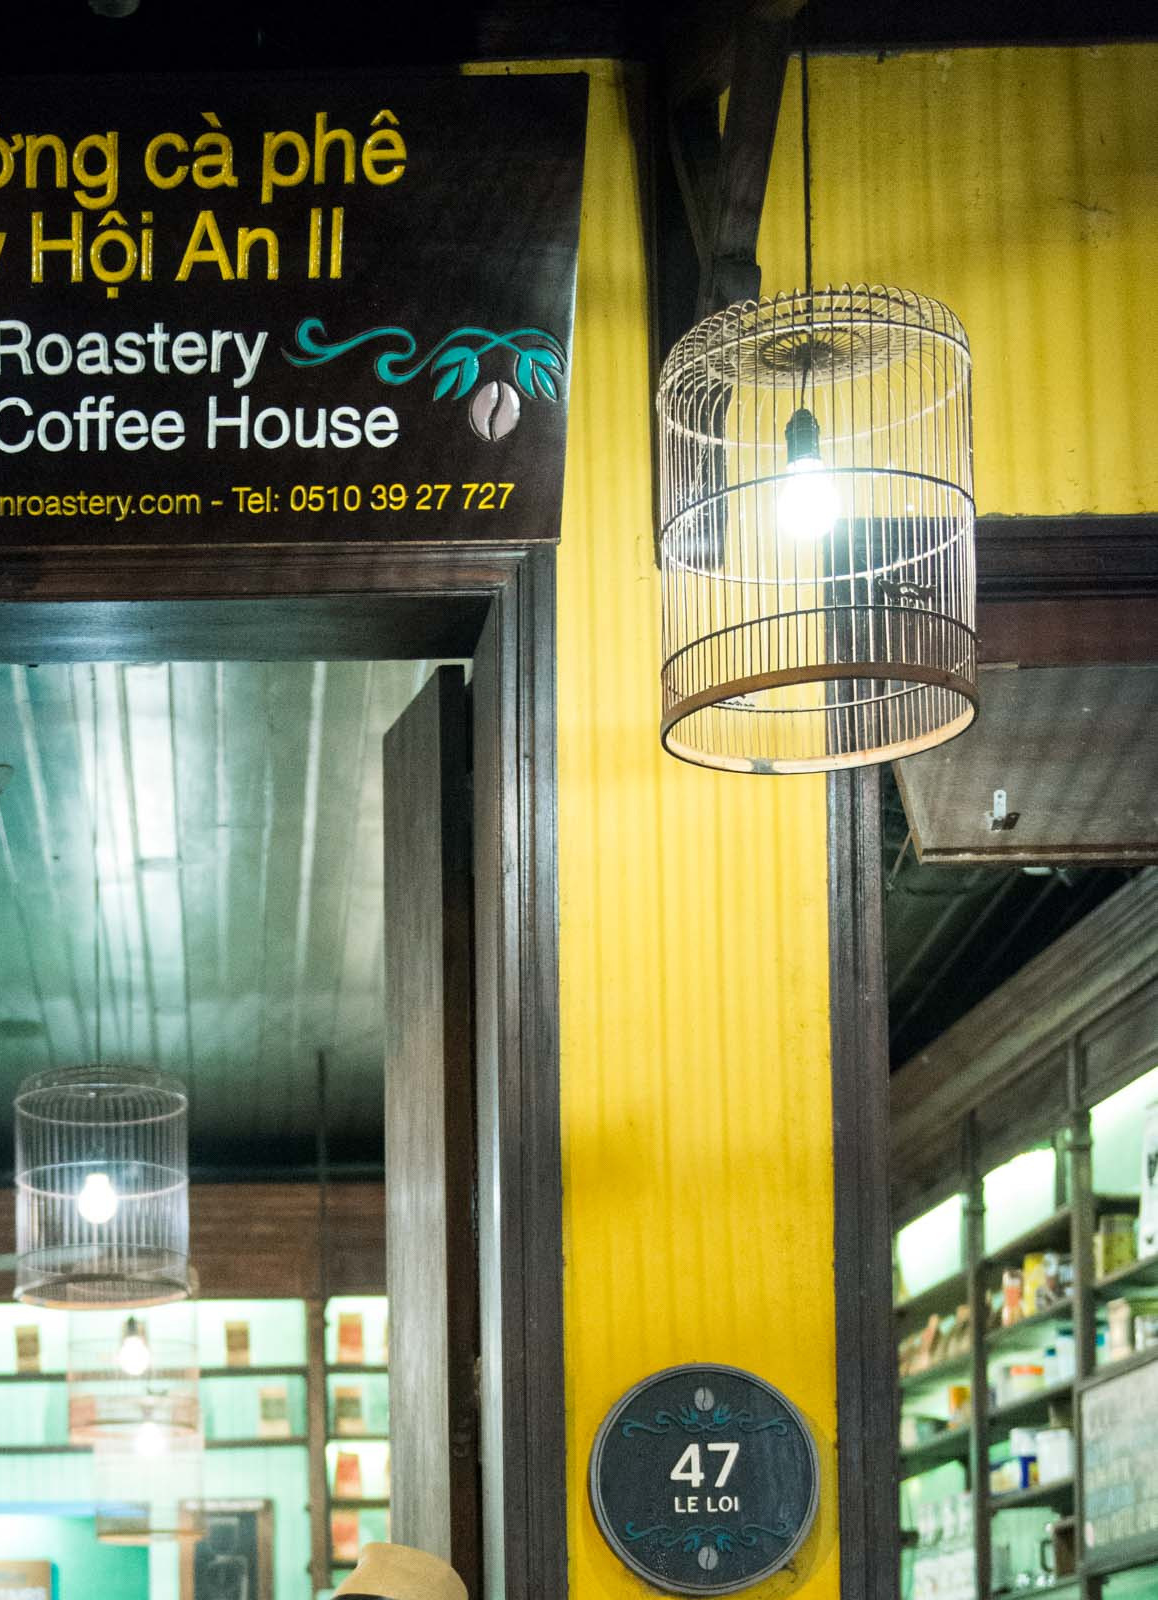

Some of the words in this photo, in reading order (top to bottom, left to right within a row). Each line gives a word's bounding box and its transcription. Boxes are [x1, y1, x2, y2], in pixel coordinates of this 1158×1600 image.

[144, 112, 238, 189] cà
[261, 109, 407, 204] phê
[31, 205, 153, 299] Hội
[175, 210, 279, 281] An
[307, 207, 344, 279] II
[207, 395, 400, 450] House
[231, 486, 280, 514] Tel:
[290, 484, 362, 512] 0510
[370, 483, 409, 511] 39
[415, 483, 453, 511] 27
[461, 481, 516, 510] 727
[670, 1442, 740, 1488] 47
[674, 1496, 699, 1513] LE
[706, 1495, 739, 1513] LOI
